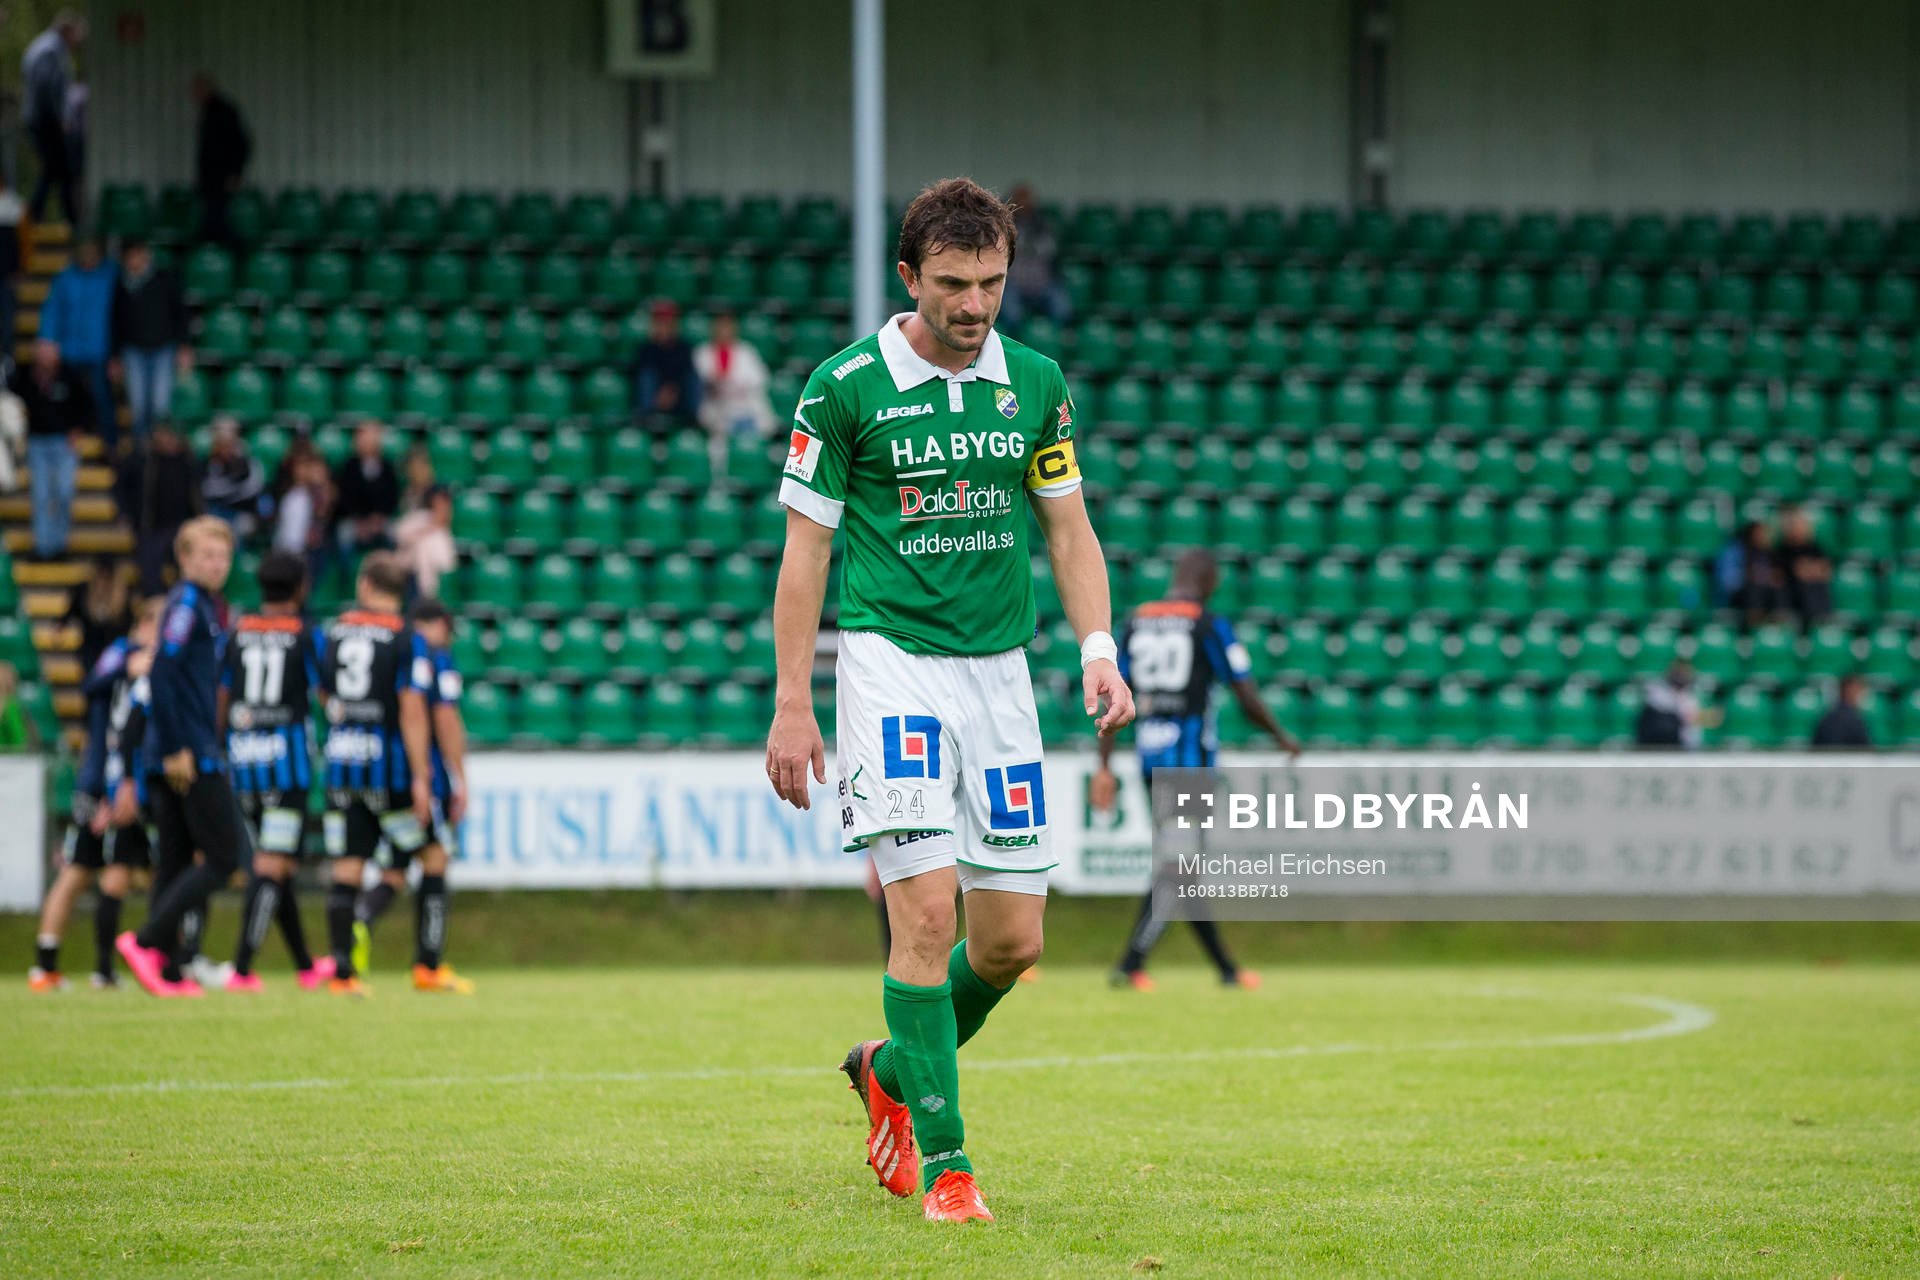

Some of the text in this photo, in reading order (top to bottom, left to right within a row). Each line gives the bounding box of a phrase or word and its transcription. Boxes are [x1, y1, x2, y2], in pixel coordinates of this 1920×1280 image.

[876, 402, 936, 422] LEGEA
[890, 431, 1025, 467] H.A BYGG
[1037, 450, 1068, 480] C
[899, 530, 1015, 555] uddevalla.se
[241, 646, 287, 705] 11
[336, 638, 375, 700] 3
[1129, 630, 1193, 692] 20
[887, 789, 925, 819] 24
[895, 831, 953, 847] LEG
[982, 834, 1038, 847] LEGEA
